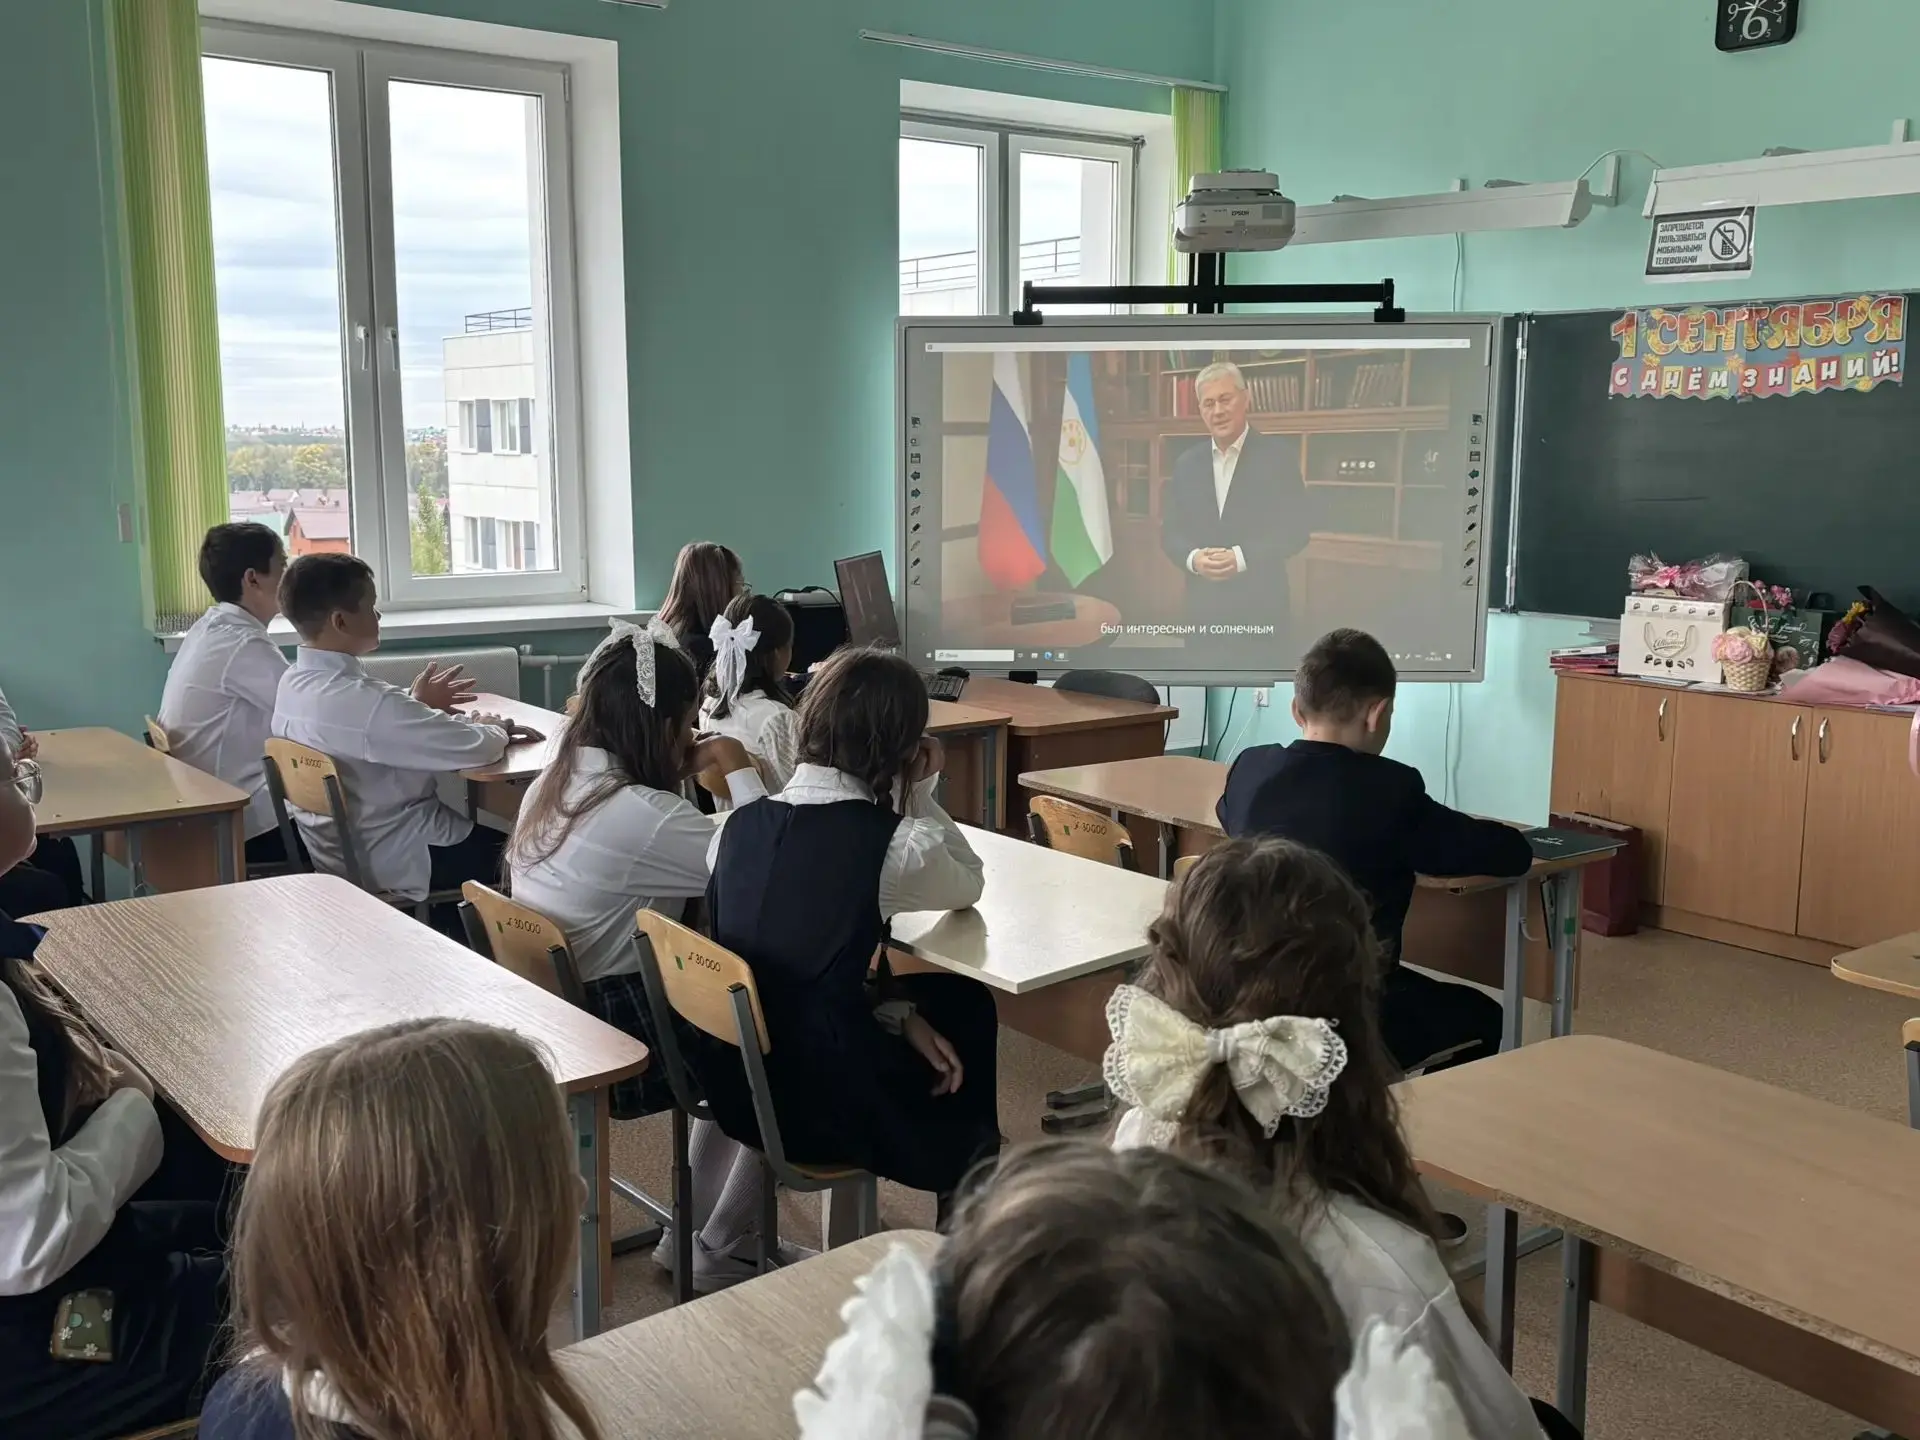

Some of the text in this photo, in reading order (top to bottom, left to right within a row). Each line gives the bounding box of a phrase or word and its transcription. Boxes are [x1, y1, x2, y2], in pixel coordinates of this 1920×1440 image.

[1728, 3, 1739, 22] 9
[1743, 8, 1769, 40] 6
[1660, 221, 1704, 232] ЗАПРЕЩАЕТСЯ
[1658, 232, 1707, 243] ПОЛЬЗОВАТЬСЯ
[1656, 244, 1703, 254] МОБИЛЬНЫМИ
[1655, 255, 1698, 265] ТЕЛЕФОНАМИ
[1611, 295, 1904, 358] 1 СЕНТЯБРЯ
[1641, 366, 1729, 391] ДНЁМ
[1742, 349, 1899, 388] ЗНАНИЙ!
[1100, 622, 1274, 636] был интересным и солнечным
